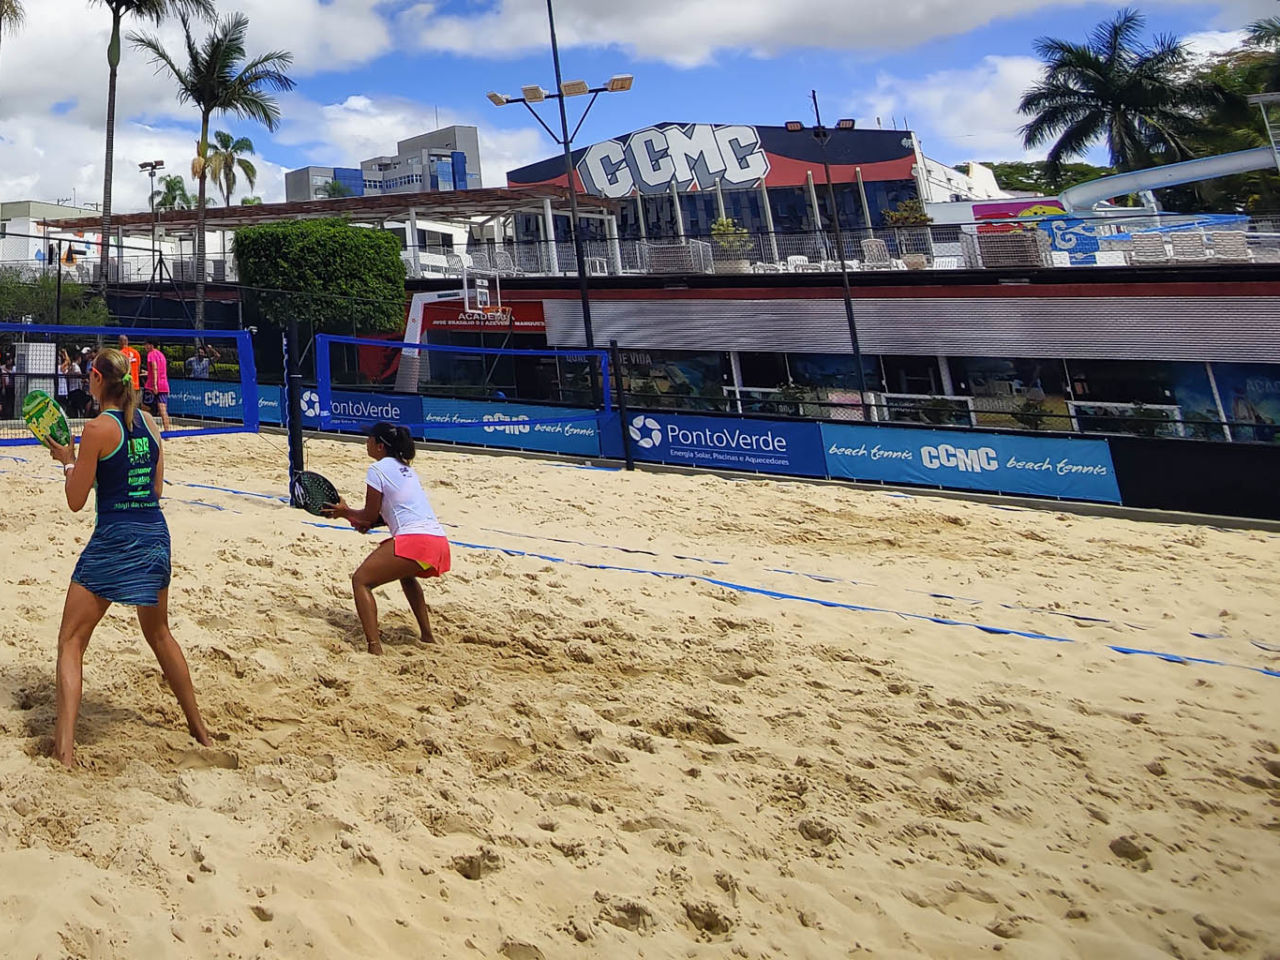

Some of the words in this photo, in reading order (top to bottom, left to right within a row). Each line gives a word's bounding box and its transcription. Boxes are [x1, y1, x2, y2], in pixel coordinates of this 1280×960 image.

[577, 123, 770, 198] CCMC
[630, 354, 653, 366] VIDA
[204, 390, 237, 408] CCMC
[330, 400, 400, 419] ontoVerde
[426, 413, 451, 423] beach
[482, 412, 531, 435] CCMC
[534, 422, 563, 433] beach
[564, 423, 595, 437] tennis
[667, 424, 787, 452] PontoVerde
[670, 449, 694, 459] Energia
[712, 452, 739, 462] Piscinas
[745, 455, 790, 466] Aquecedores
[828, 443, 868, 457] beach
[870, 444, 913, 461] tennis
[920, 443, 999, 473] CCMC
[1006, 456, 1053, 472] beach
[1056, 458, 1108, 476] tennis
